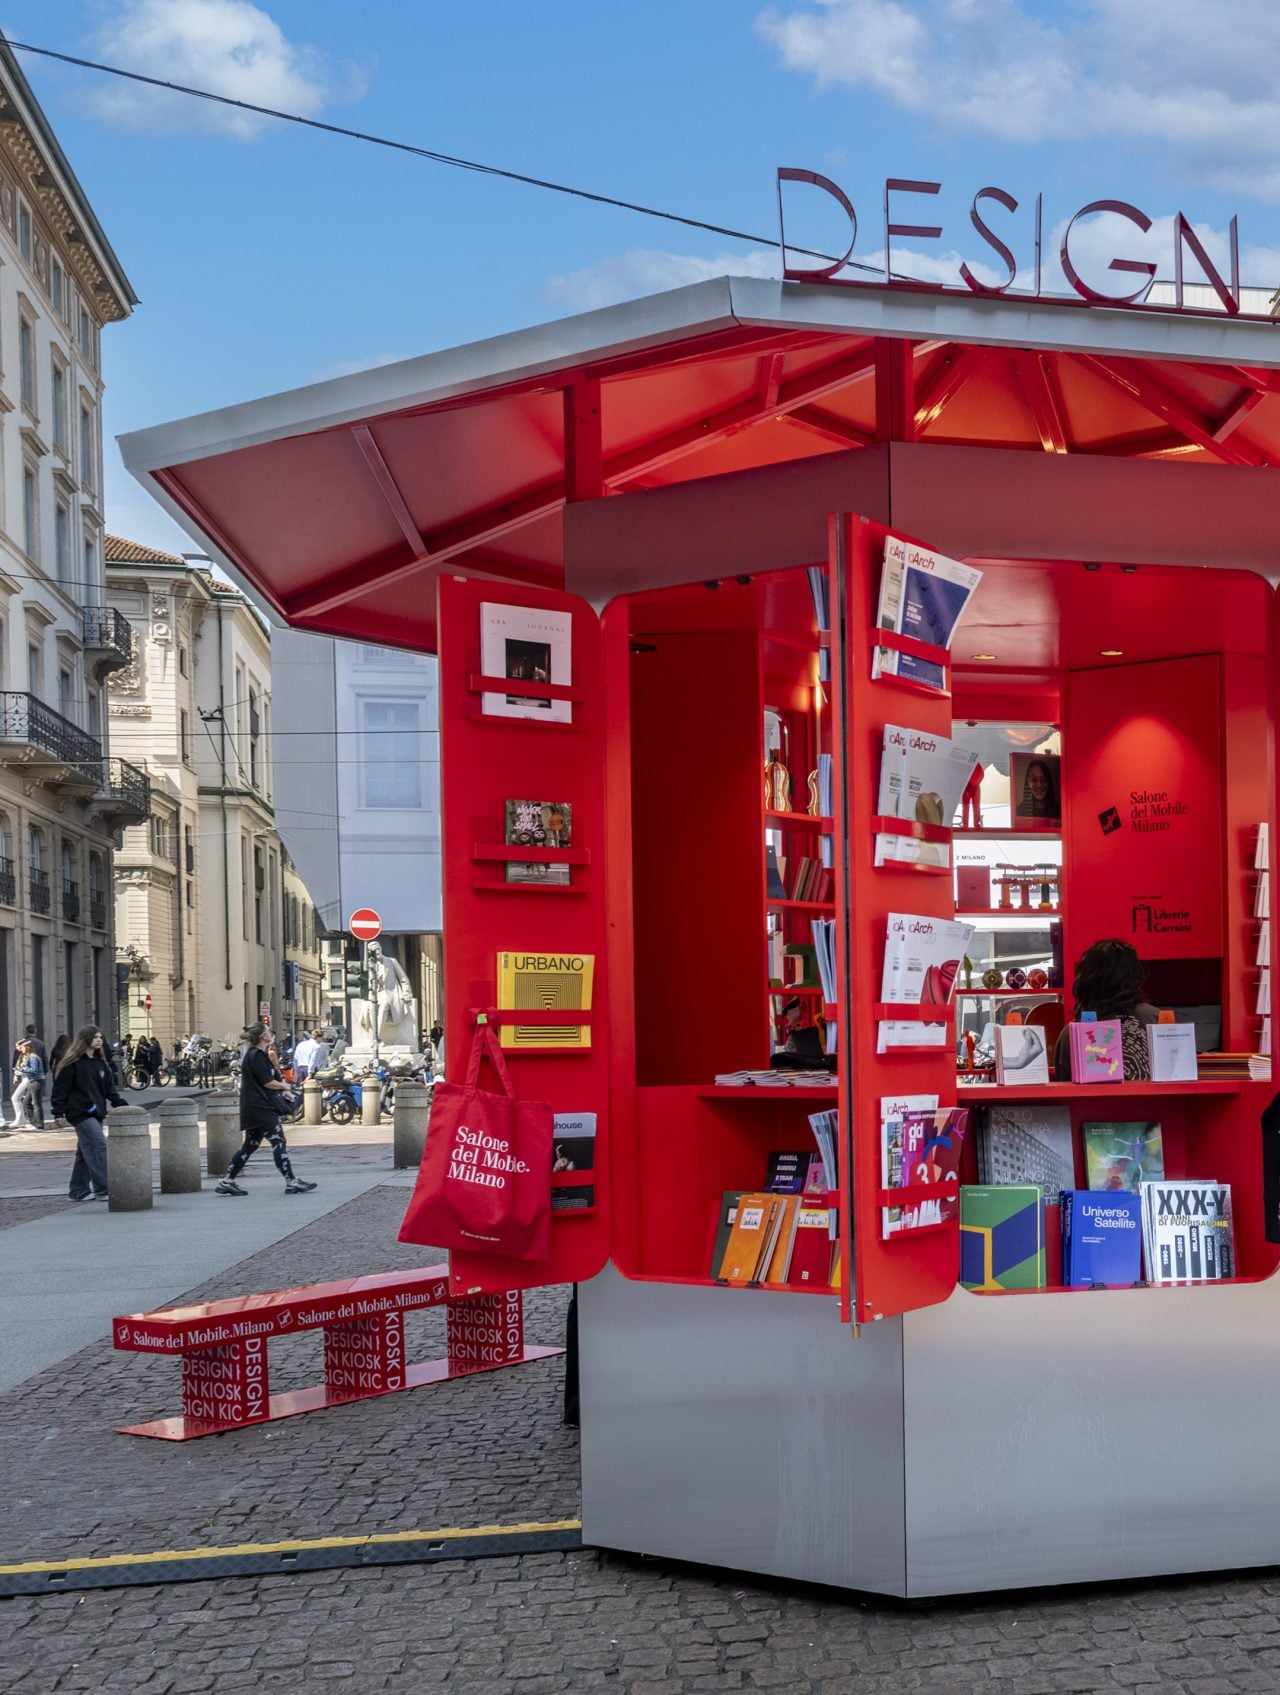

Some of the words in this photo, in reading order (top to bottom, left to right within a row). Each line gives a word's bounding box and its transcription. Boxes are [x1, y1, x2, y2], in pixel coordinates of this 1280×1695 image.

[776, 167, 1239, 316] DESIGN
[909, 734, 936, 753] ioArch
[1130, 790, 1168, 805] Salone
[1130, 806, 1148, 819] del
[1131, 819, 1170, 833] Milano
[1153, 909, 1190, 920] Librerie
[1153, 920, 1191, 933] Corraini
[514, 956, 584, 972] URBANO
[455, 1125, 509, 1152] Salone
[451, 1145, 478, 1165] del
[447, 1161, 505, 1189] Milano
[1082, 1206, 1130, 1217] Universo
[1157, 1190, 1227, 1216] XXX-Y
[1094, 1216, 1136, 1228] Satellite
[298, 1306, 336, 1326] Salone
[338, 1304, 355, 1319] del
[447, 1307, 494, 1326] DESIGN
[506, 1289, 519, 1358] DESIGN
[133, 1330, 165, 1348] Salone
[166, 1334, 184, 1349] del
[324, 1331, 372, 1351] DESIGN
[385, 1311, 401, 1372] KIOSK
[464, 1326, 503, 1344] KIOSK
[182, 1358, 233, 1380] DESIGN
[341, 1351, 381, 1370] KIOSK
[245, 1337, 263, 1418] DESIGN
[200, 1380, 242, 1401] KIOSK
